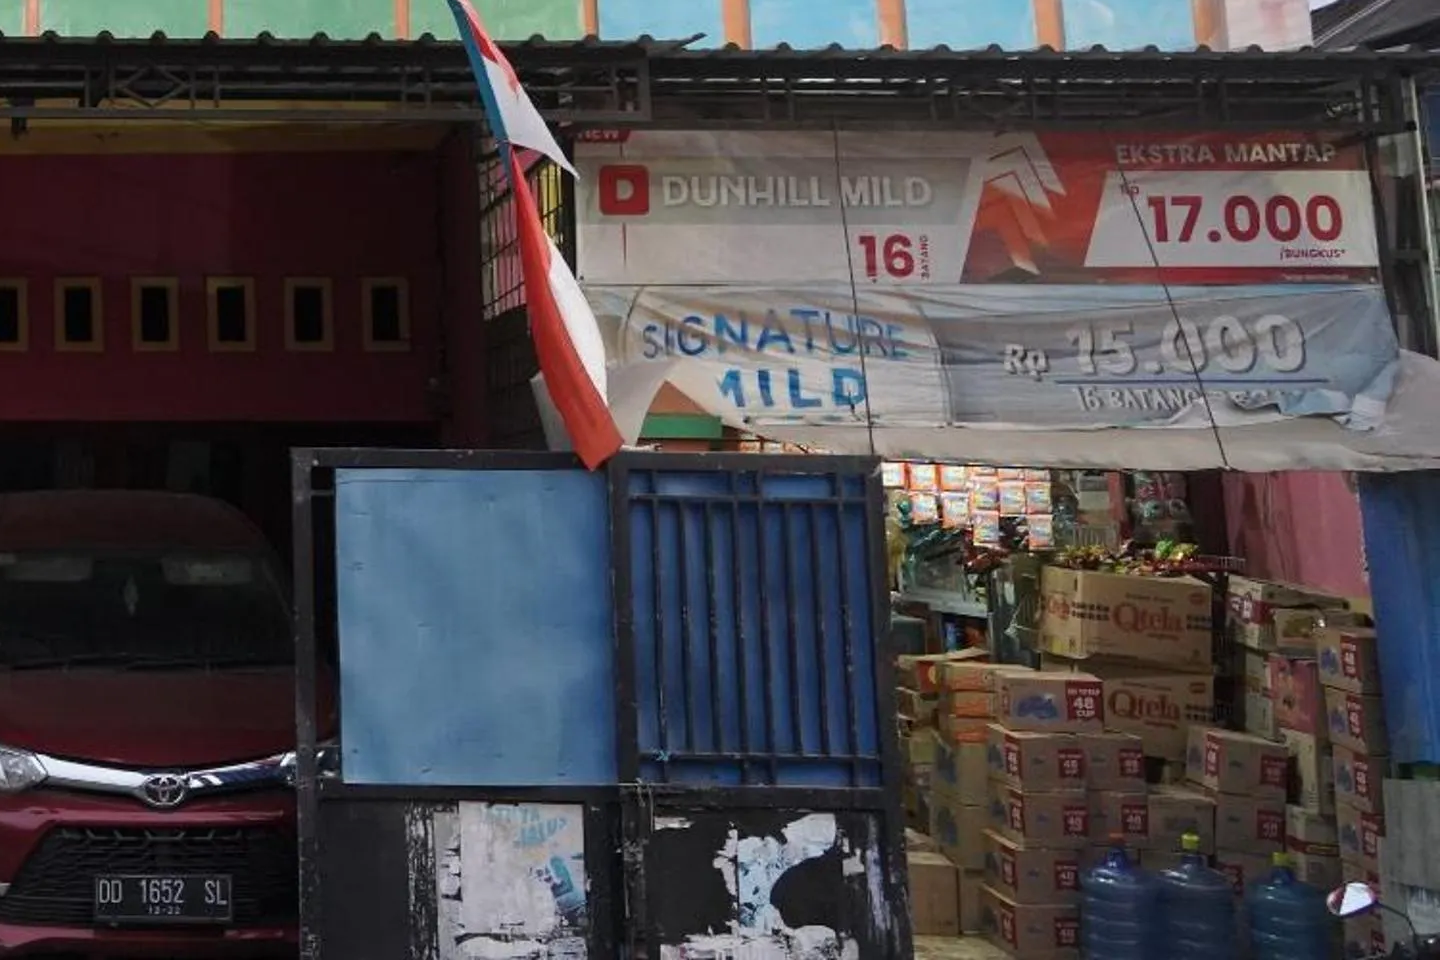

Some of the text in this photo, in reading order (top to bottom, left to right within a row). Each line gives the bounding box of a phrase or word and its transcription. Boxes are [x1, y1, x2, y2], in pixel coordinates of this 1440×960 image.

[1116, 142, 1337, 164] EKSTRA MANTAP
[663, 176, 933, 208] DUNHILL MILD
[1147, 195, 1343, 243] 17.000
[859, 234, 914, 277] 16
[642, 308, 908, 359] SIGNATURE
[1003, 315, 1307, 382] Rp 15.000
[1078, 385, 1104, 412] 16
[1113, 602, 1185, 633] Qtela
[1073, 696, 1095, 709] 48
[1108, 689, 1181, 720] Qtela
[99, 878, 229, 906] DD 1652 SL
